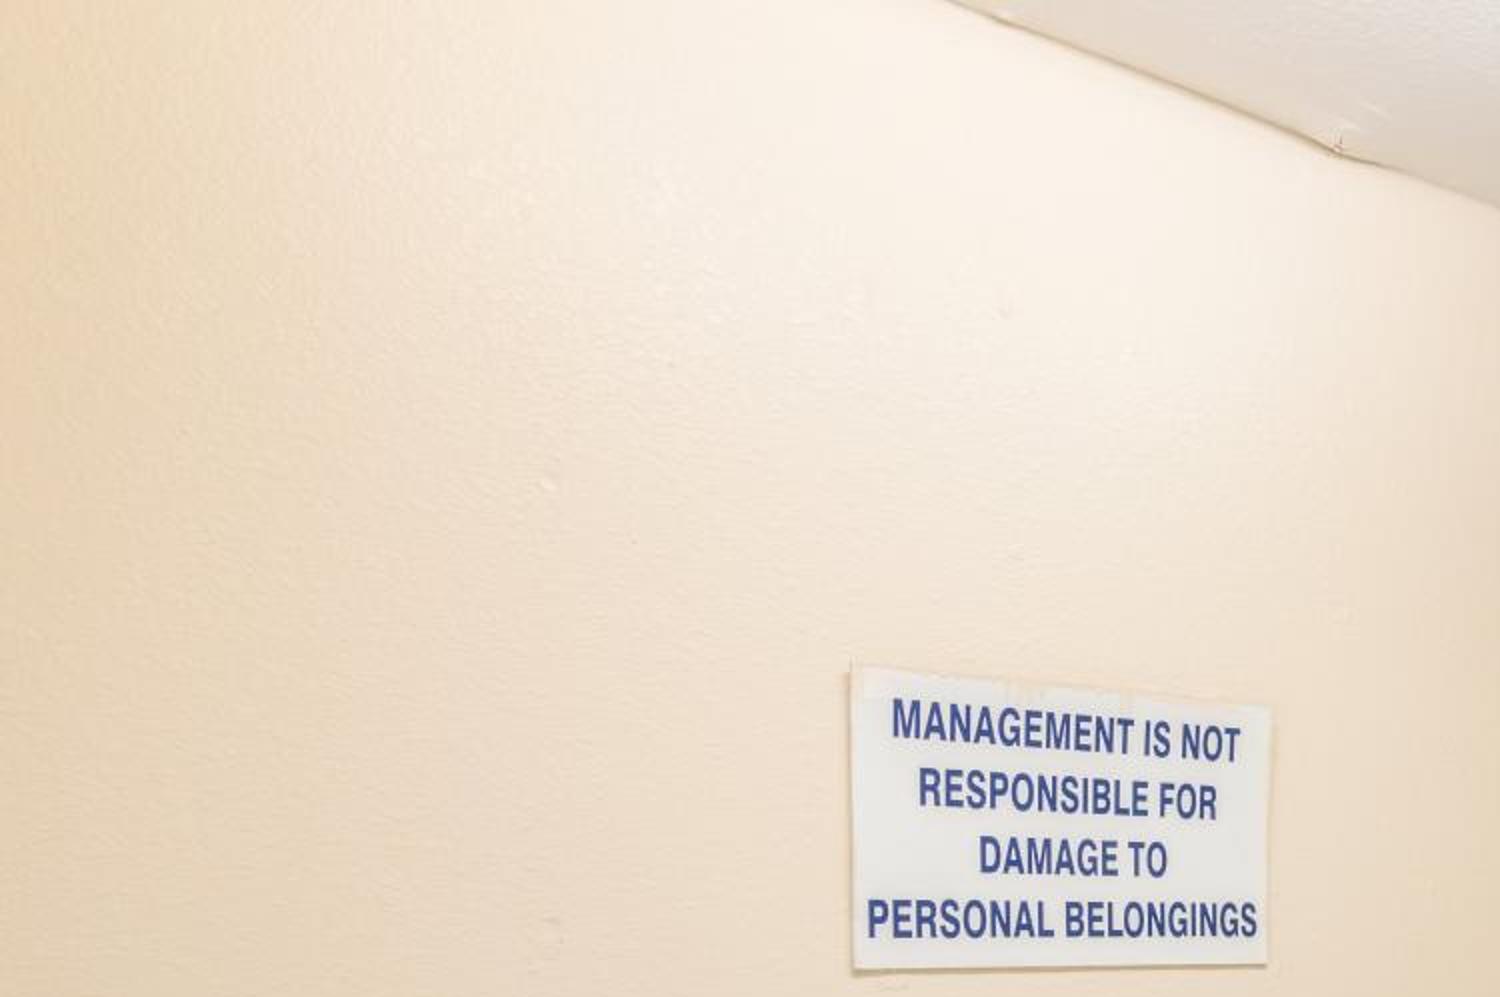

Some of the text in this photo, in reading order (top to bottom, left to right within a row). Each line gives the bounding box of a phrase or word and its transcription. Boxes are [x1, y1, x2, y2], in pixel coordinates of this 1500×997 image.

[892, 697, 1241, 763] MANAGEMENT IS NOT
[919, 767, 1217, 821] RESPONSIBLE FOR
[979, 835, 1168, 879] DAMAGE TO
[867, 898, 1258, 939] PERSONAL BELONGINGS
